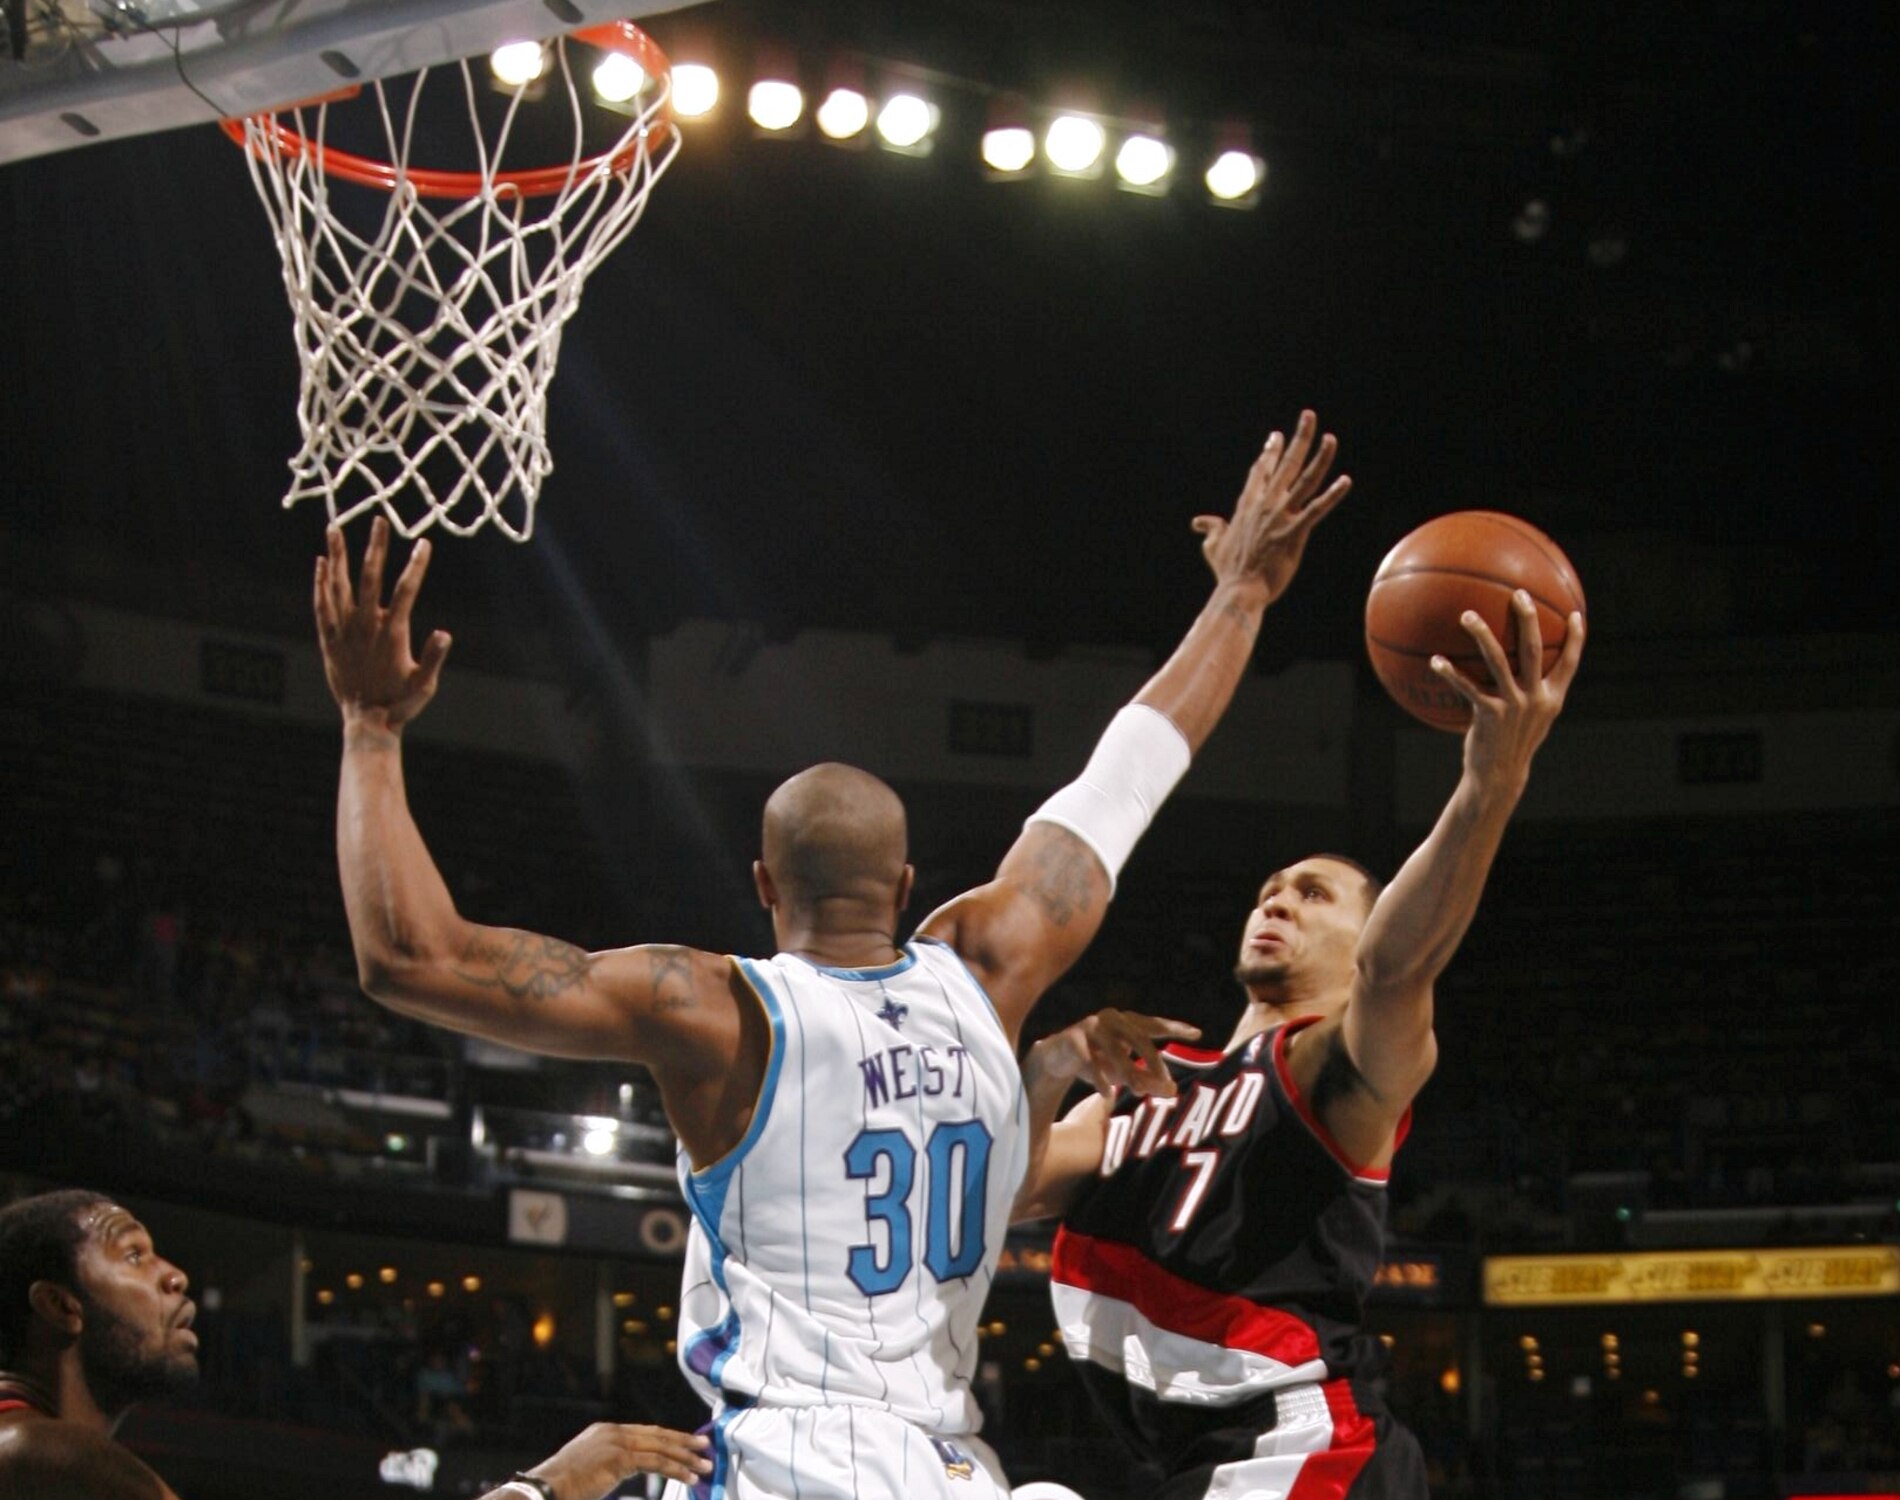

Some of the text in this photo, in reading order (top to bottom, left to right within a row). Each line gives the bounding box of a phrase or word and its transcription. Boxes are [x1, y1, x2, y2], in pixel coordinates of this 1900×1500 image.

[858, 1045, 969, 1110] WEST
[843, 1118, 994, 1297] 30
[1168, 1147, 1219, 1234] 7
